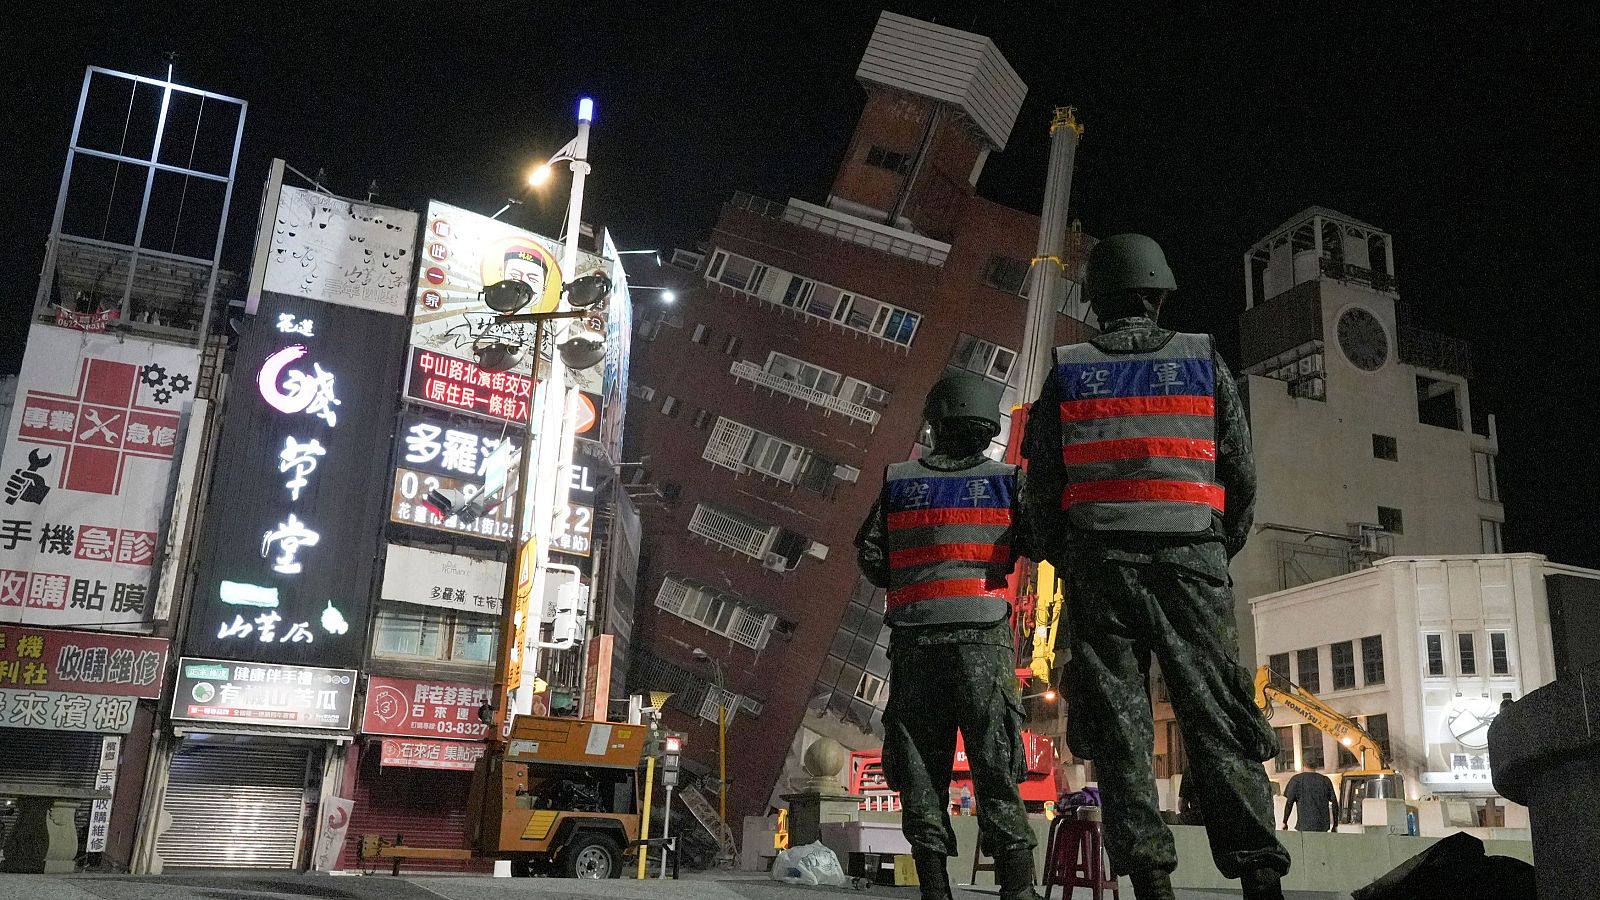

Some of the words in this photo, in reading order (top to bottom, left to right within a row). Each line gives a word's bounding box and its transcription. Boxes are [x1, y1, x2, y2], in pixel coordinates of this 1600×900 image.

[420, 352, 541, 399] 中山路北濱街交叉
[1080, 362, 1185, 398] 空軍
[25, 407, 75, 432] 專業
[127, 422, 176, 447] 急修
[903, 478, 991, 508] 空軍
[0, 519, 155, 563] 手機急診
[0, 570, 148, 615] 收購貼膜
[217, 611, 314, 643] 山苦瓜
[56, 644, 160, 686] 收購維修
[436, 720, 490, 736] 03-8327
[1284, 699, 1319, 724] KOMATSU
[400, 742, 441, 760] 石來店
